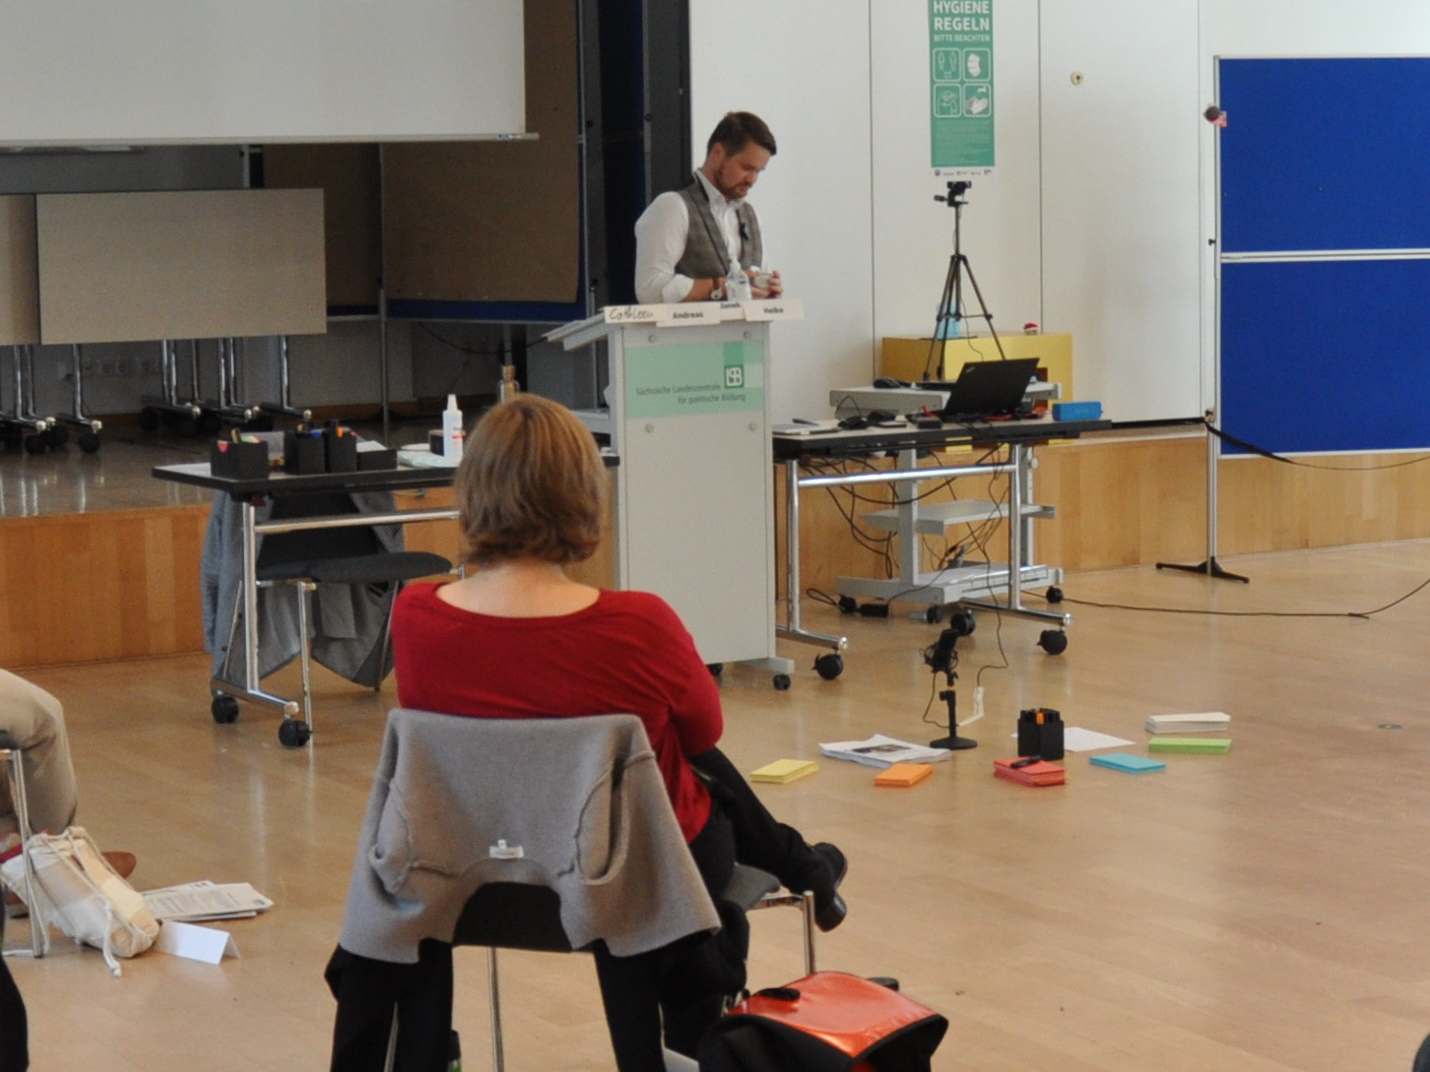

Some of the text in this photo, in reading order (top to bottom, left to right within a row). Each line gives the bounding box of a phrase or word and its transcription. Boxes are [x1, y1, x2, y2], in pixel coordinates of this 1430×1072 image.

[933, 0, 990, 14] HYGIENE
[933, 17, 990, 31] REGELN
[933, 34, 991, 42] BITTE BEACHTEN
[672, 311, 704, 319] Andreas
